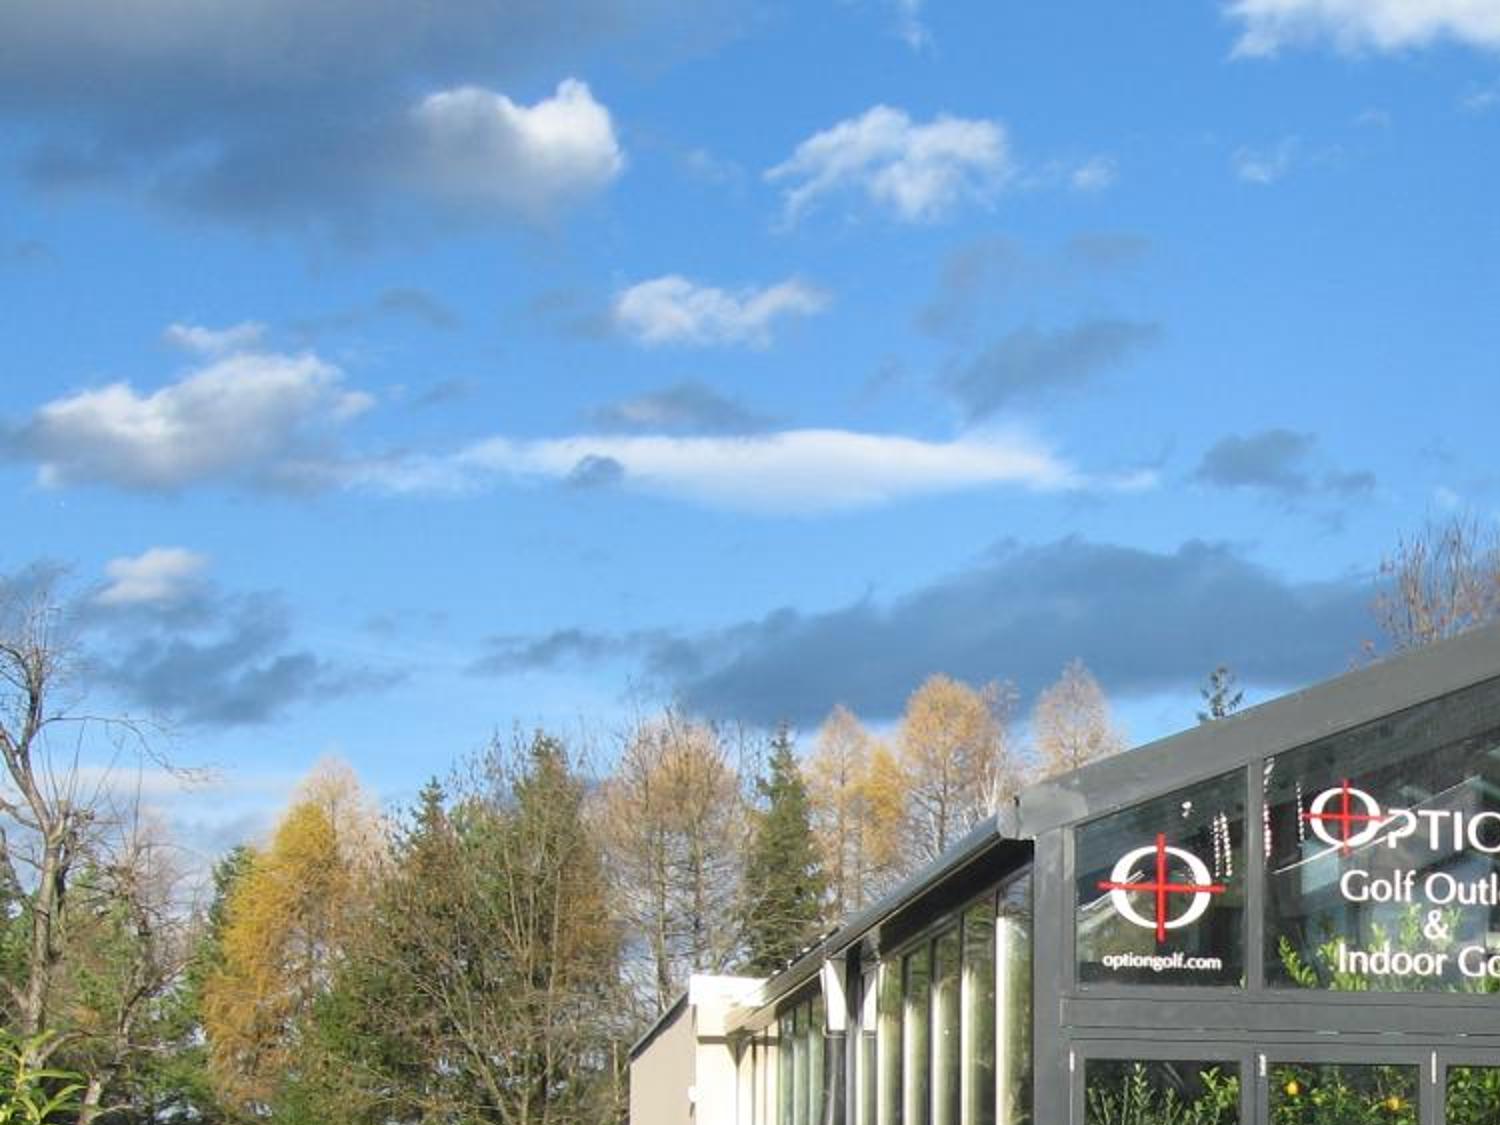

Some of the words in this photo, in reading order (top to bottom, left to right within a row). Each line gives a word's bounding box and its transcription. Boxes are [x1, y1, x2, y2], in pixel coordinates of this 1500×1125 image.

[1340, 869, 1416, 902] Golf
[1424, 909, 1449, 940] &
[1102, 951, 1222, 971] optiongolf.com
[1338, 942, 1448, 975] Indoor
